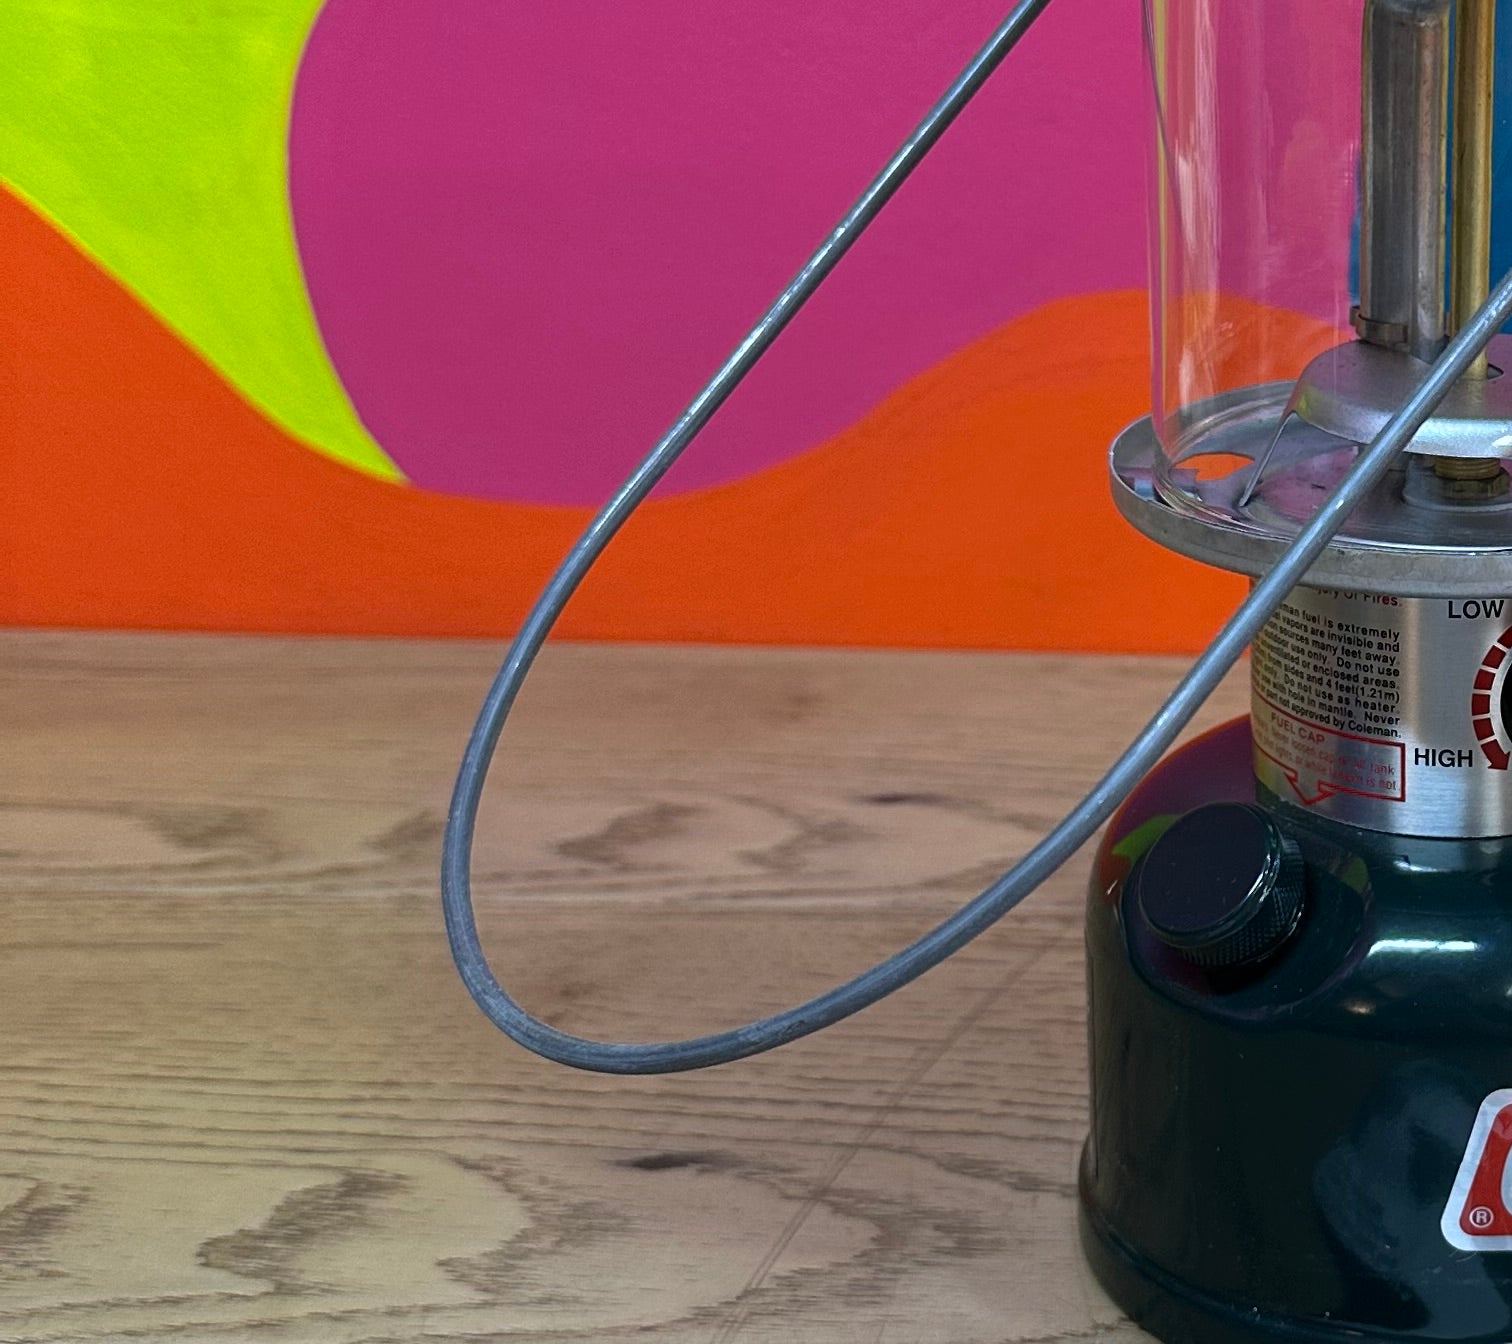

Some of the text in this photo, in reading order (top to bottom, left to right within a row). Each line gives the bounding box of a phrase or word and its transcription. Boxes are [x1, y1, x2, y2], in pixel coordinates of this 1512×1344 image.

[1448, 600, 1504, 619] LOW
[1282, 613, 1309, 633] vapors
[1310, 625, 1325, 638] are
[1327, 629, 1374, 649] invisible
[1377, 641, 1400, 654] and
[1302, 610, 1321, 625] fuel
[1324, 616, 1334, 628] is
[1337, 622, 1400, 642] extremely
[1279, 626, 1309, 645] sources
[1311, 639, 1338, 656] many
[1341, 645, 1361, 660] feet
[1307, 672, 1323, 687] and
[1326, 678, 1332, 689] 4
[1313, 662, 1359, 683] enclosed
[1363, 675, 1400, 689] areas.
[1337, 656, 1351, 669] Do
[1355, 660, 1374, 673] not
[1377, 666, 1400, 678] use
[1297, 680, 1312, 695] not
[1315, 686, 1334, 702] use
[1337, 694, 1350, 705] as
[1355, 698, 1400, 715] heater.
[1307, 695, 1316, 708] in
[1364, 711, 1401, 726] Never
[1271, 711, 1296, 738] FUEL
[1298, 727, 1325, 745] CAP
[1292, 702, 1331, 725] approved
[1333, 714, 1346, 731] by
[1348, 720, 1402, 739] Coleman.
[1370, 763, 1395, 776] tank
[1414, 748, 1473, 768] HIGH
[1379, 778, 1396, 790] not
